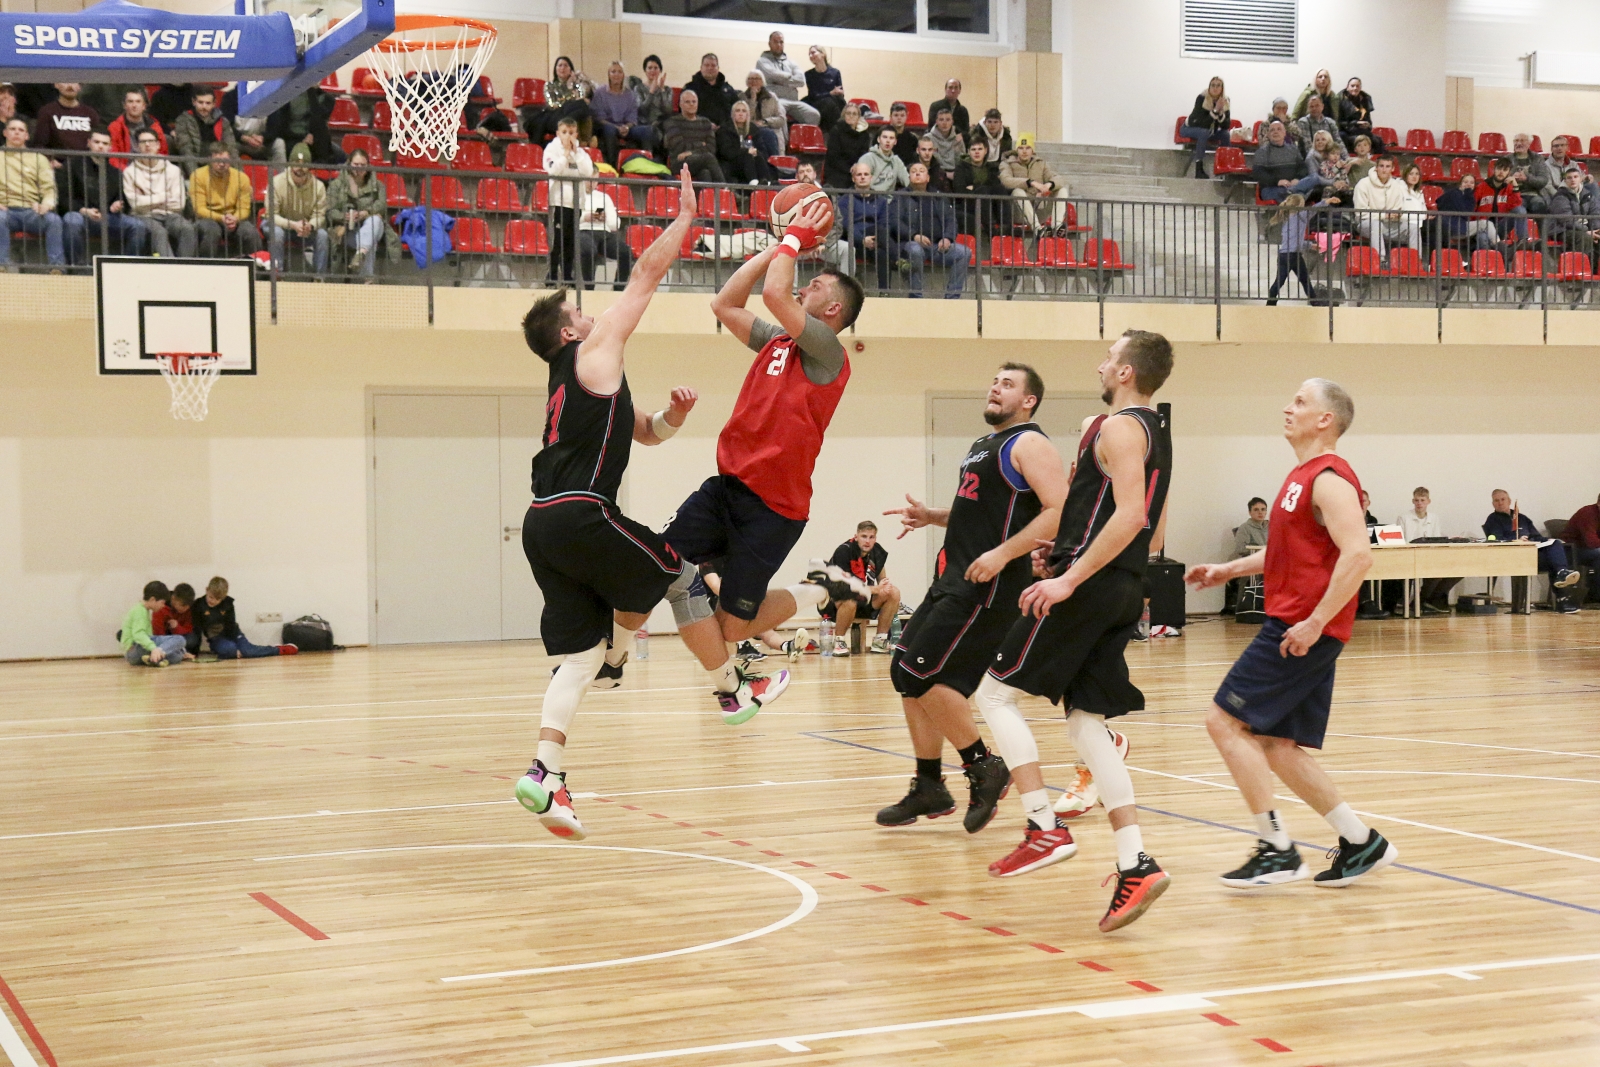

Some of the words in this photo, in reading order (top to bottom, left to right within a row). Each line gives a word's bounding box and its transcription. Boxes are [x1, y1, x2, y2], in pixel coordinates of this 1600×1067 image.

[14, 25, 118, 49] SPORT
[121, 29, 242, 57] SYSTEM
[52, 115, 91, 132] VANS
[957, 471, 981, 501] 22
